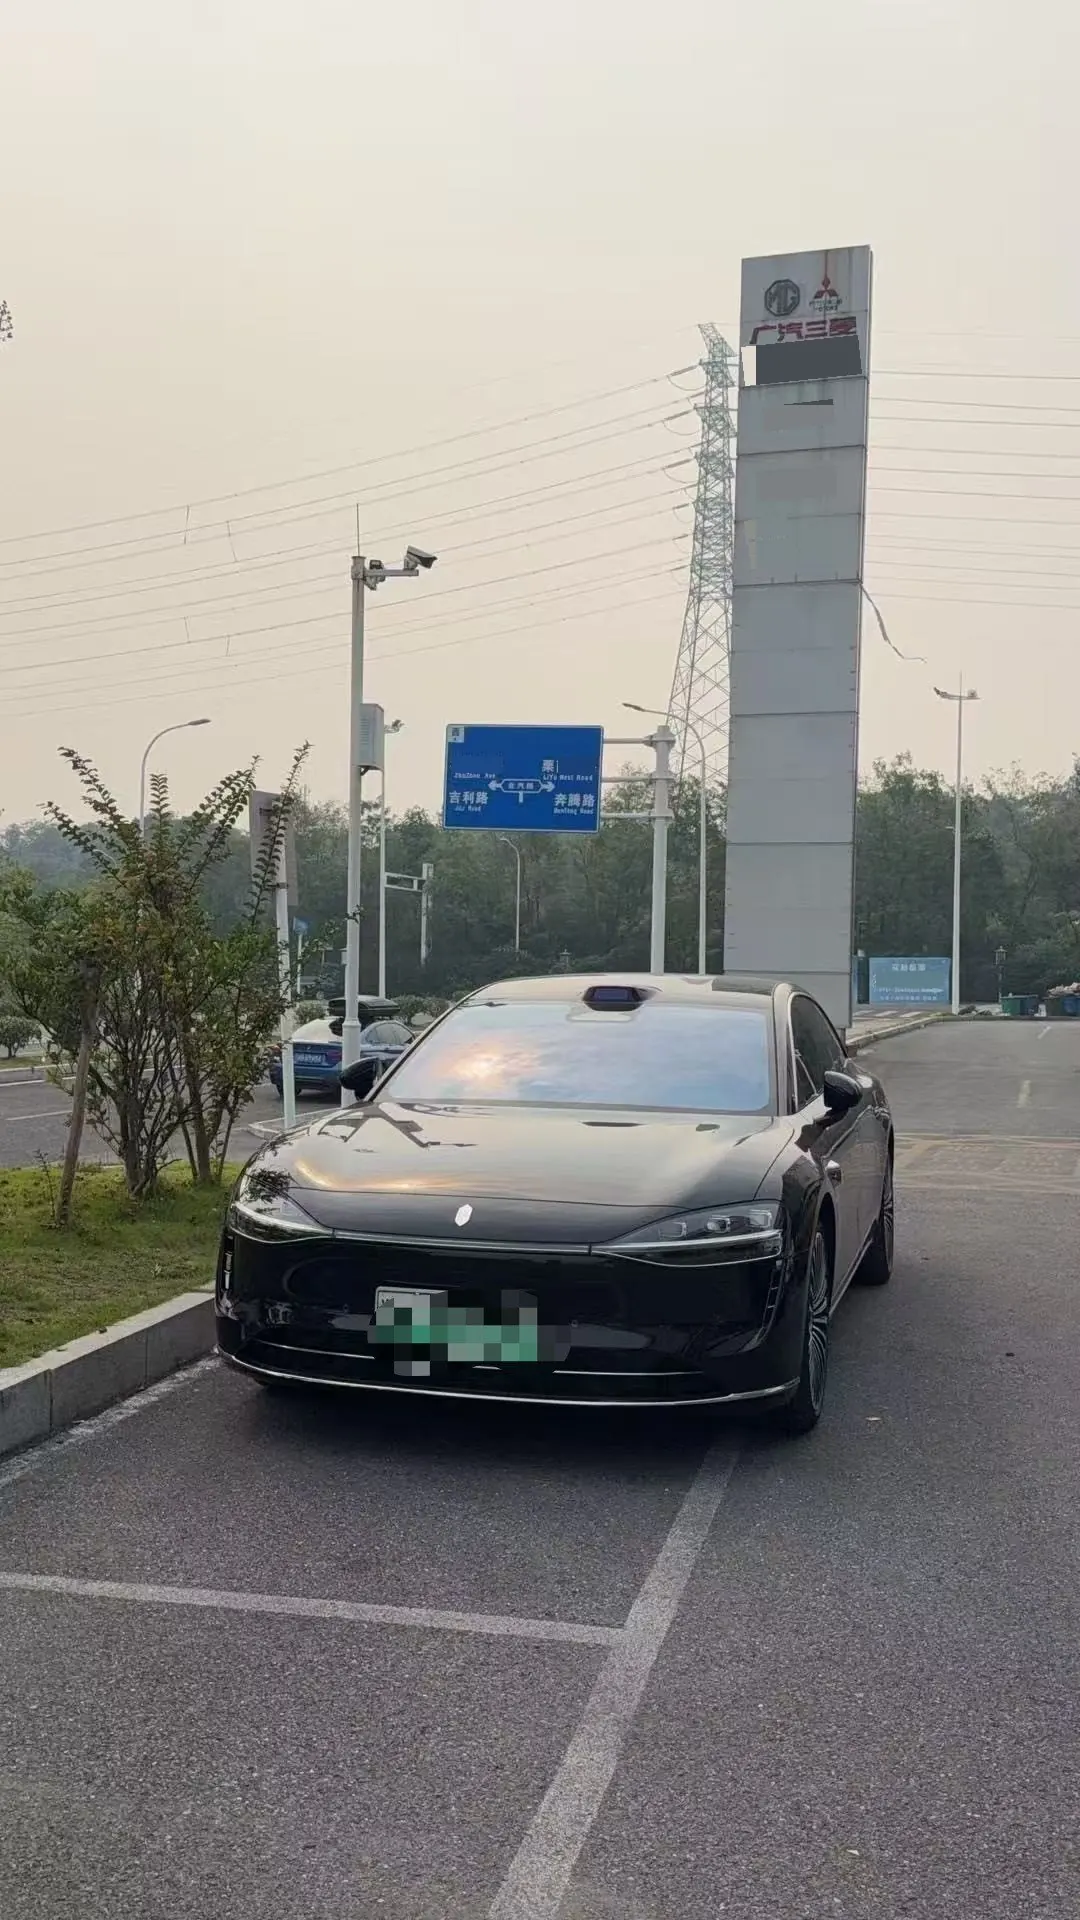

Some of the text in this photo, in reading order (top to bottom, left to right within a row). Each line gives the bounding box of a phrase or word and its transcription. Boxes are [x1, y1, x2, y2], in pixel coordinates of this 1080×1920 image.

[766, 282, 799, 315] MG
[449, 791, 488, 804] 吉利路
[555, 793, 595, 807] 奔腾路
